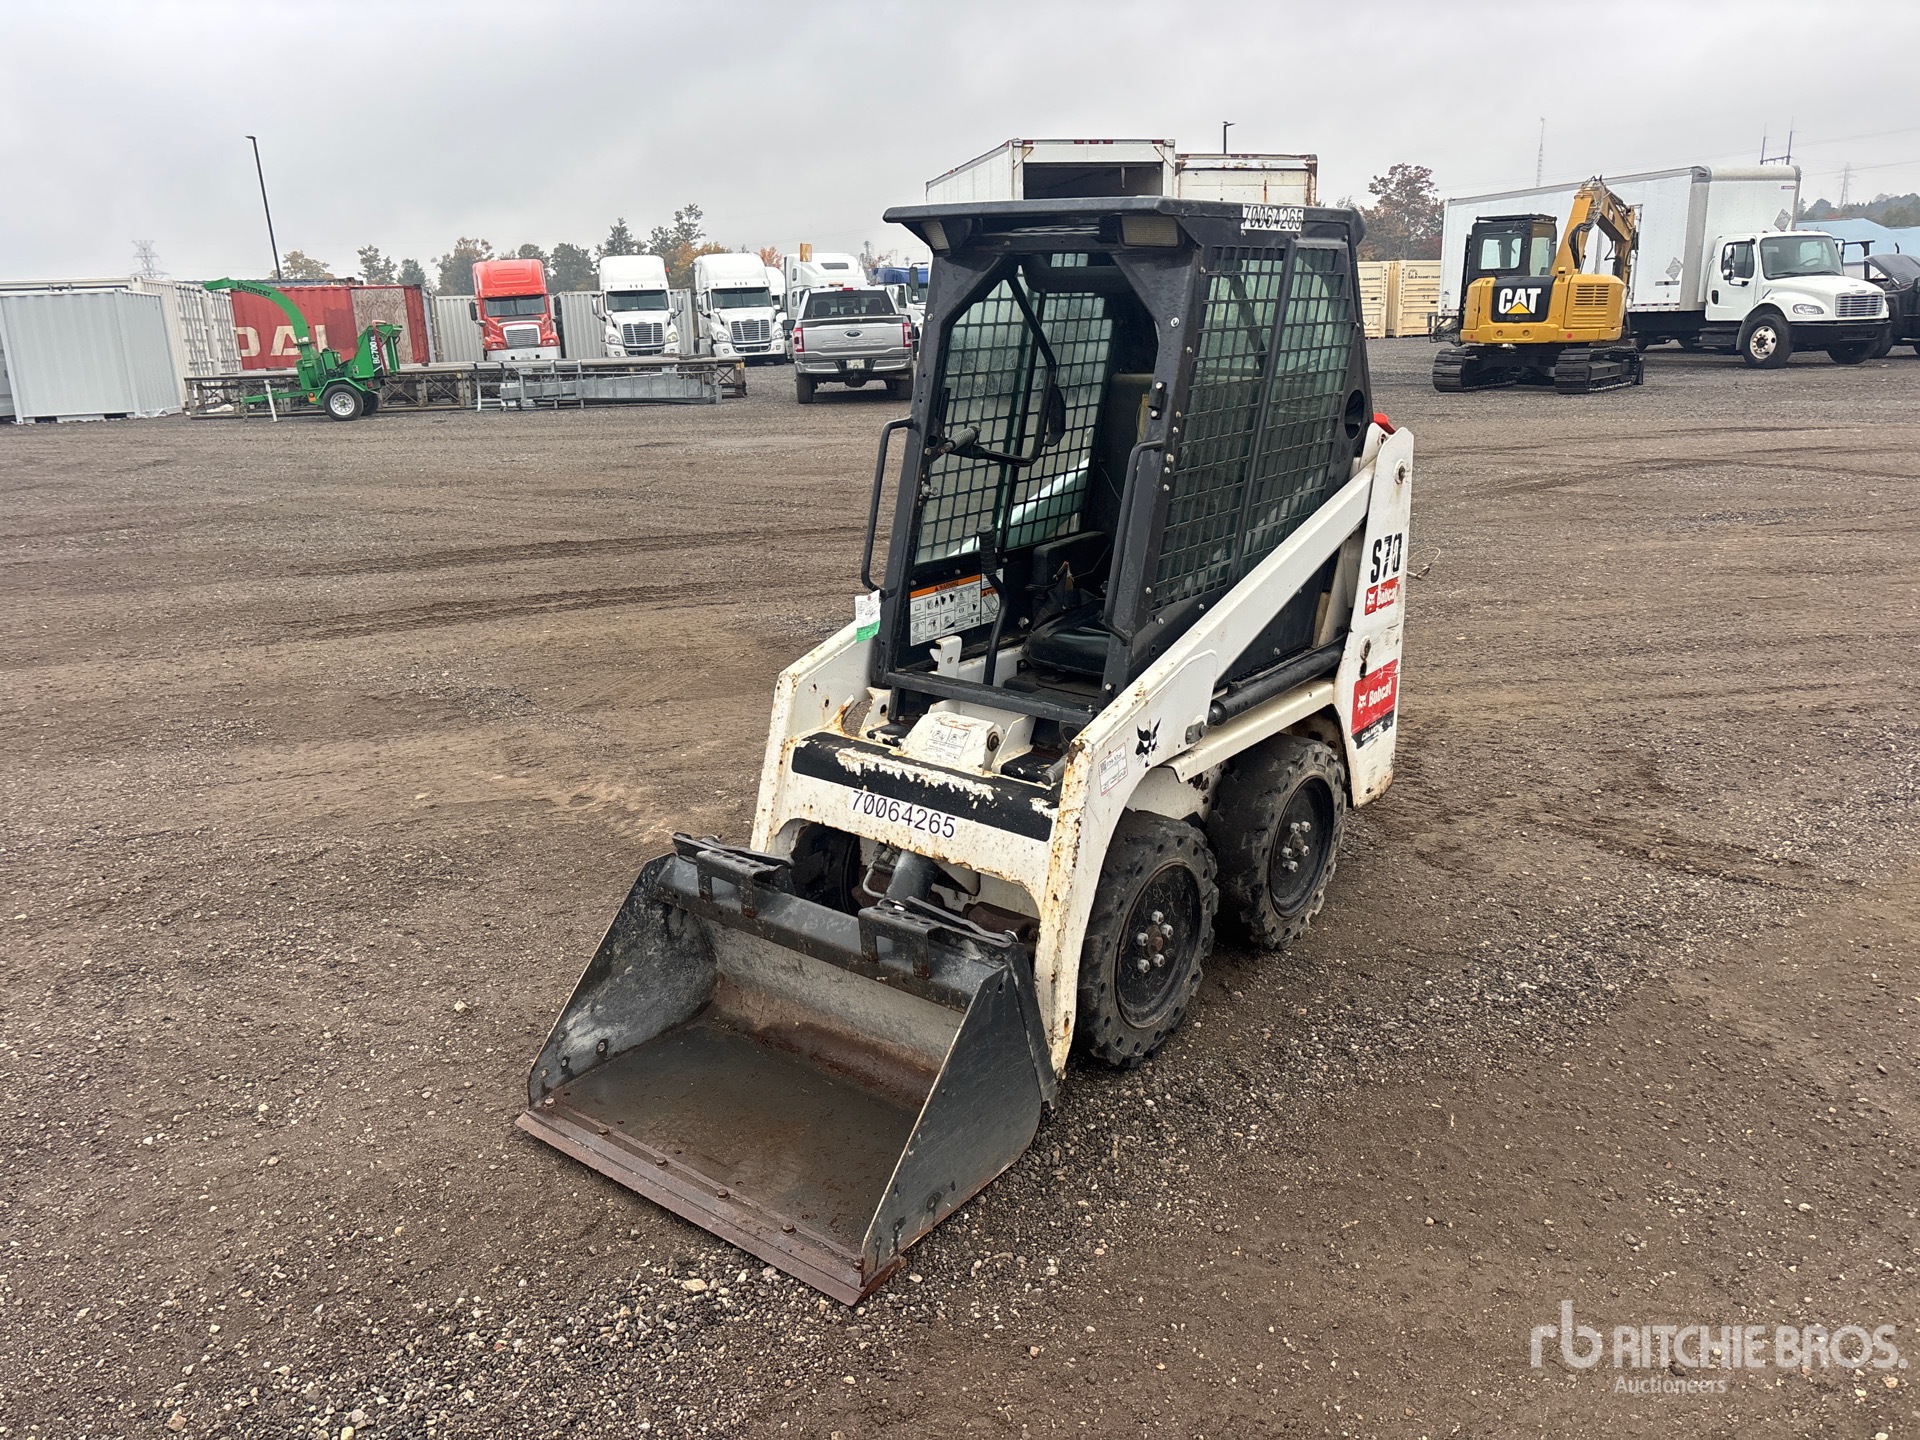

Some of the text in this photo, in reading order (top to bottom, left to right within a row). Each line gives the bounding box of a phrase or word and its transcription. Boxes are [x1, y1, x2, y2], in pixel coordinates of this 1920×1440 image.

[1243, 205, 1302, 230] 70064265
[237, 282, 272, 297] Vermeer
[1498, 288, 1541, 314] CAT
[1370, 532, 1402, 584] S70
[1368, 680, 1392, 708] Bobcat
[852, 790, 956, 838] 70064265
